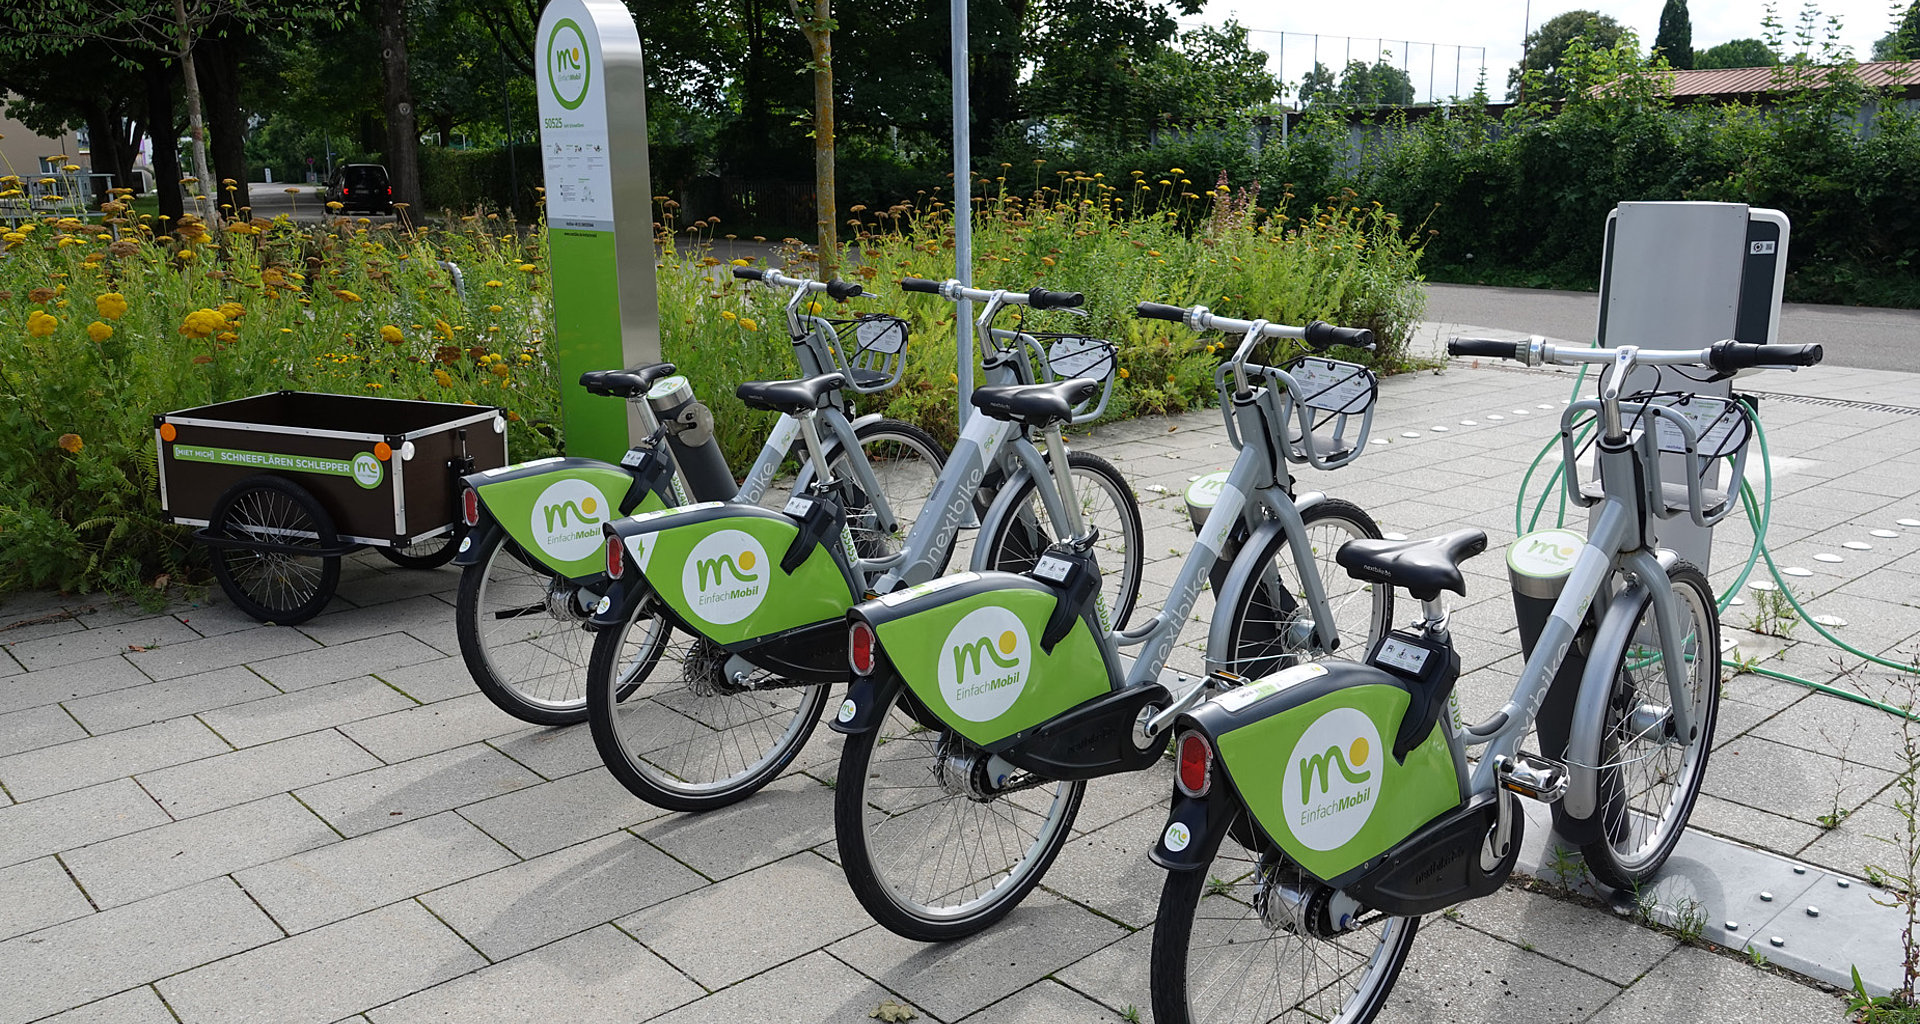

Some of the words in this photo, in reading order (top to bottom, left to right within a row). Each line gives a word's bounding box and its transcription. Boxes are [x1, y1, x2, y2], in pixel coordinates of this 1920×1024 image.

[220, 451, 294, 468] SCHNEEFLÄREN
[295, 459, 350, 473] SCHLEPPER
[926, 467, 983, 563] nextbike
[547, 526, 602, 546] EinfachMobil
[840, 526, 856, 563] 355453
[699, 585, 760, 606] EinfachMobil
[1149, 566, 1208, 679] nextbike
[955, 672, 1021, 701] EinfachMobil
[1511, 641, 1569, 756] extbike
[1300, 787, 1371, 827] EinfachMobil
